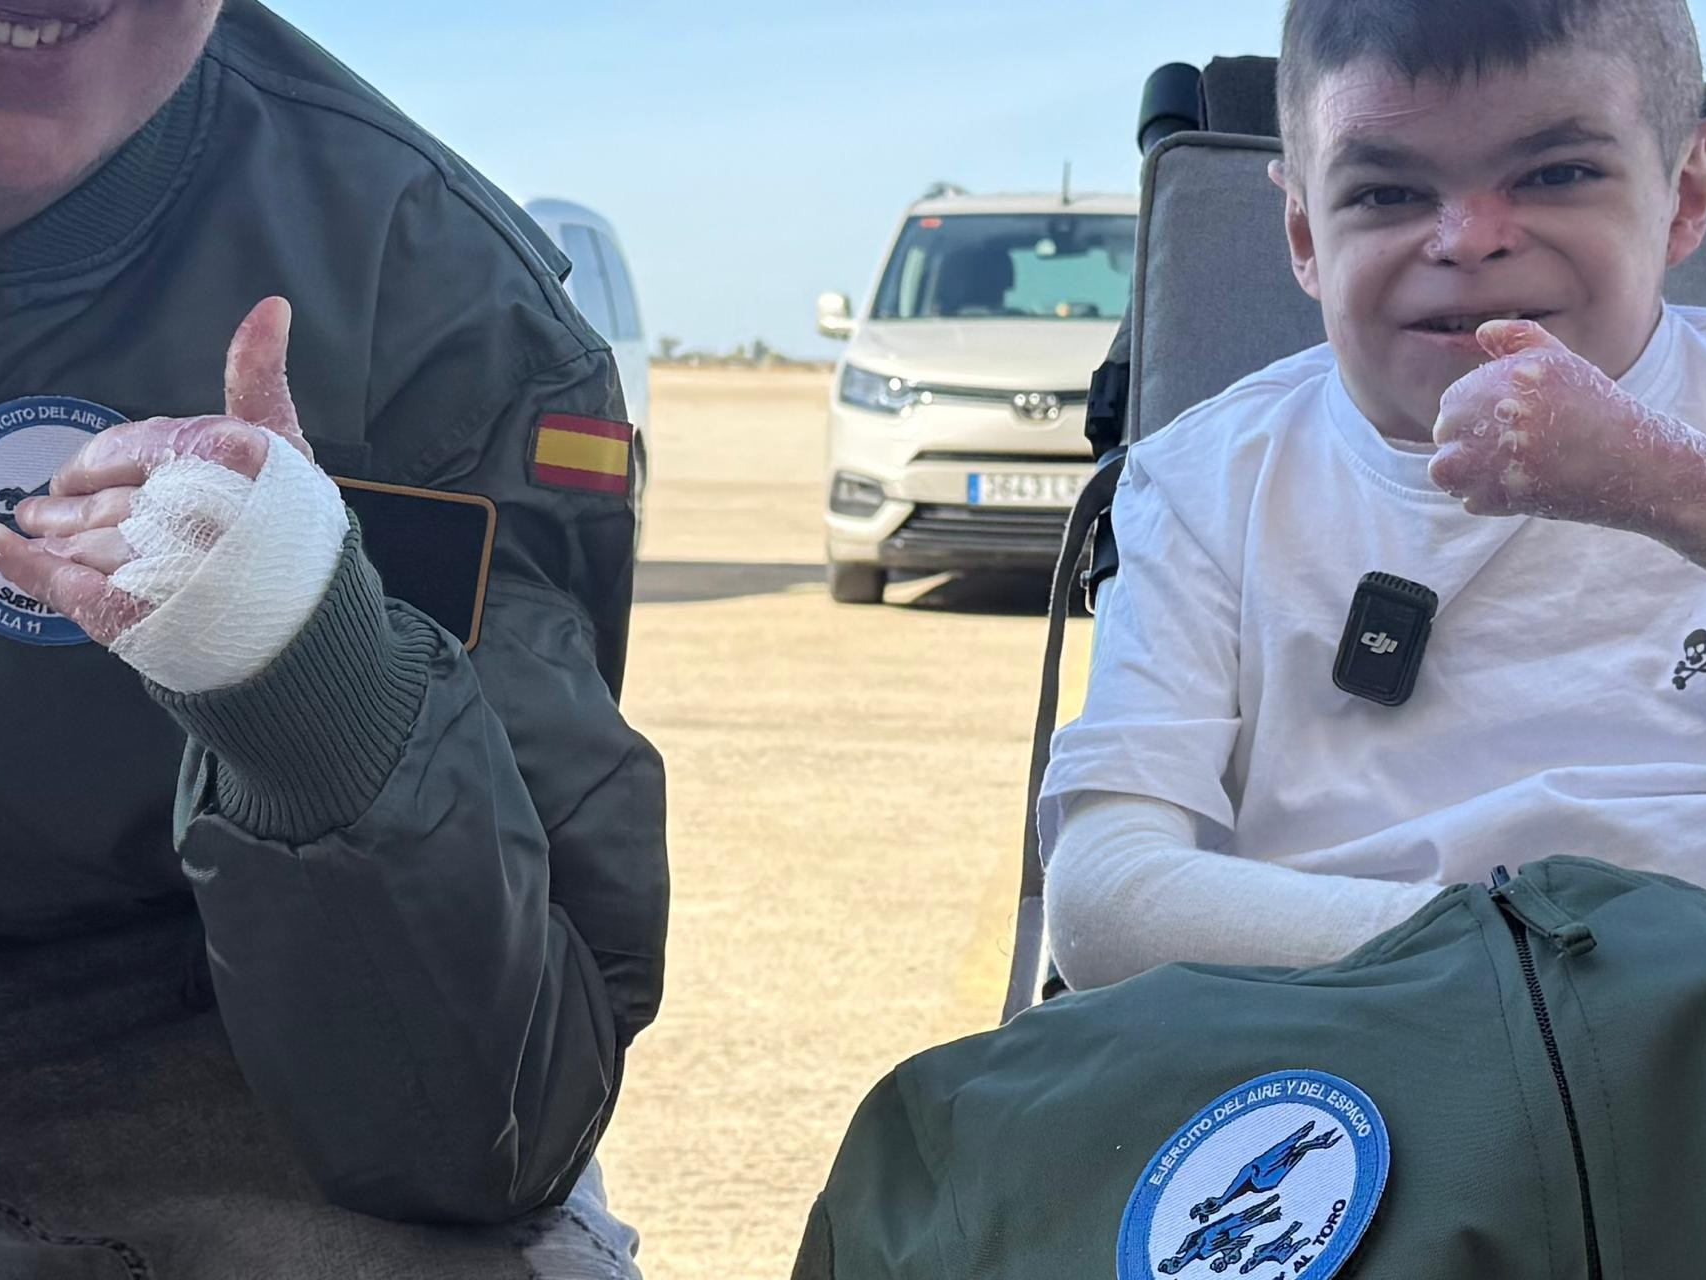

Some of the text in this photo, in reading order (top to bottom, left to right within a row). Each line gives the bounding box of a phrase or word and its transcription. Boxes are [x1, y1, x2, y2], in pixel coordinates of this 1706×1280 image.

[38, 406, 68, 419] DEL
[71, 410, 107, 430] AIRE
[27, 621, 41, 634] 11
[1214, 1097, 1245, 1121] DEL
[1247, 1083, 1281, 1104] AIRE
[1287, 1080, 1296, 1094] Y
[1297, 1081, 1324, 1099] DEL
[1326, 1090, 1371, 1137] ESPACIO
[1294, 1255, 1315, 1273] AL
[1312, 1199, 1346, 1247] TORO
